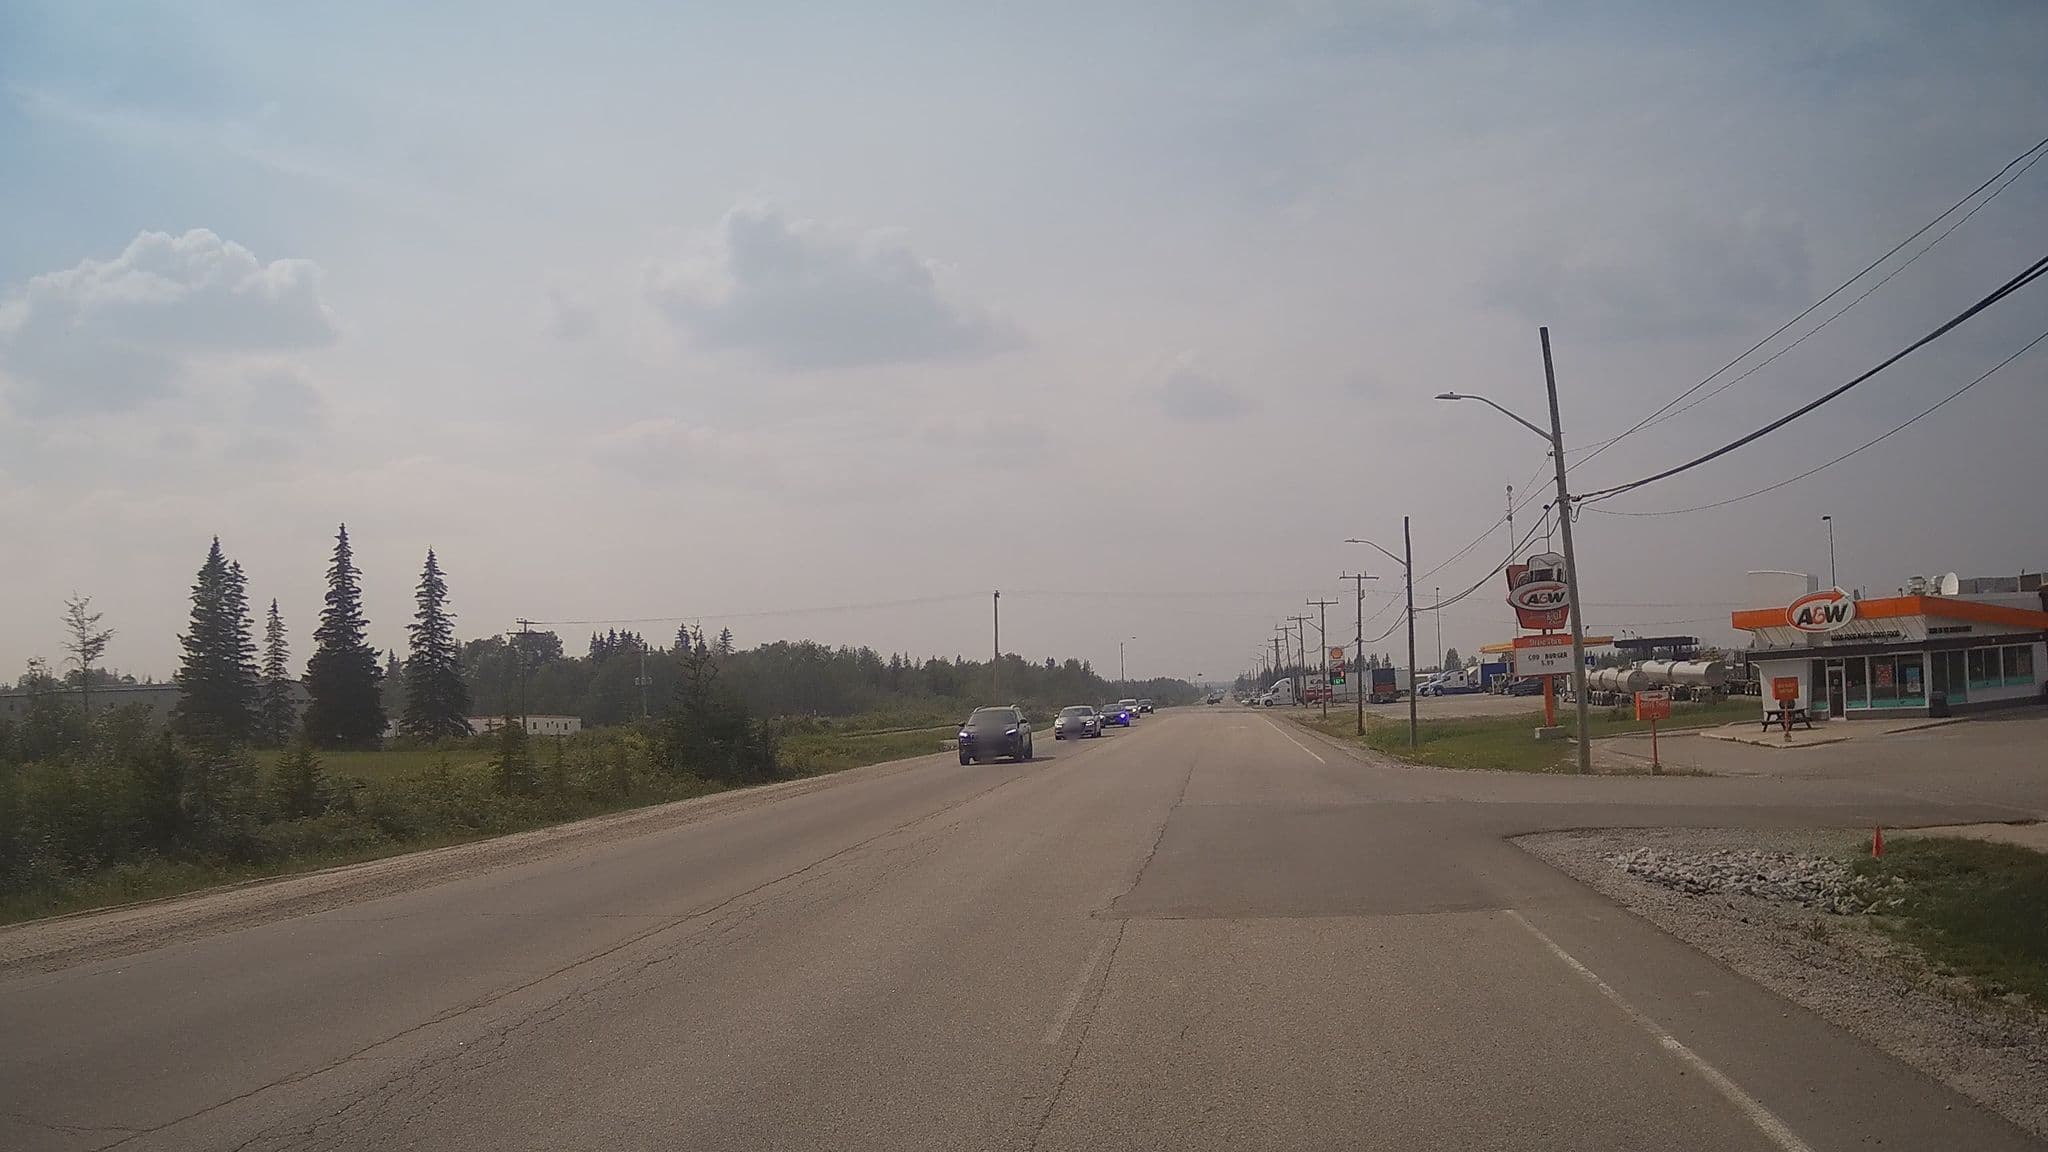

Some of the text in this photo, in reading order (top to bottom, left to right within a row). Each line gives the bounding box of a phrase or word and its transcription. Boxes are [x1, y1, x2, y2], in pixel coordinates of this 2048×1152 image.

[1526, 592, 1565, 605] A&W
[1797, 603, 1848, 625] A&W
[1544, 651, 1567, 660] BURGER
